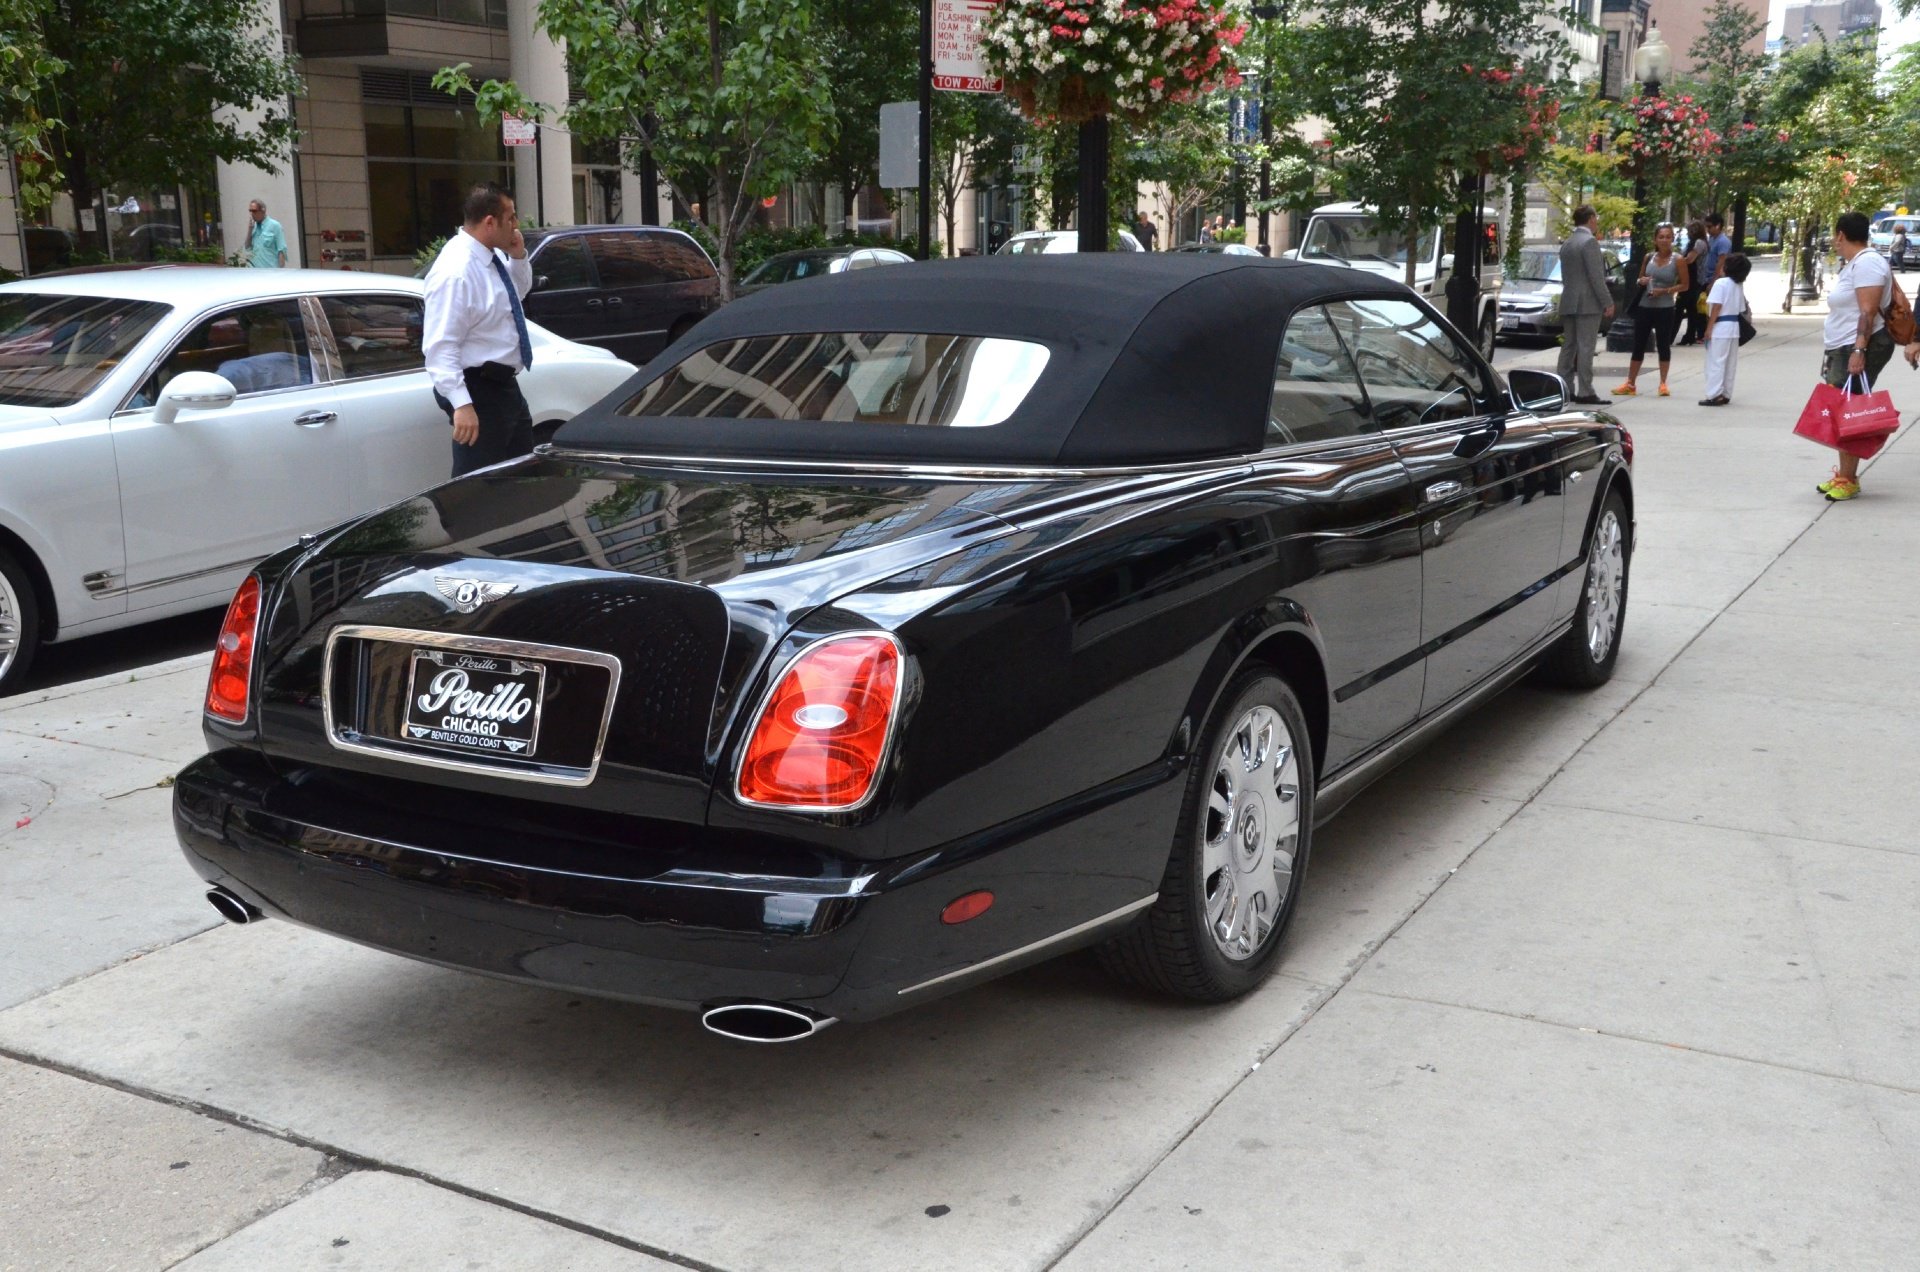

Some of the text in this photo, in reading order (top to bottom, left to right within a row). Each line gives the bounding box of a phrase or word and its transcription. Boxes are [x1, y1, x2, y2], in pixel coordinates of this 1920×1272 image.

[938, 3, 953, 11] USE
[938, 12, 974, 23] FLASHING
[937, 32, 955, 40] MON
[937, 51, 950, 59] FRI
[956, 53, 973, 61] SUN
[937, 76, 996, 90] TOW ZONE
[455, 655, 498, 670] Perillo
[417, 668, 532, 723] Perillo
[441, 716, 499, 736] CHICAGO
[430, 730, 502, 748] BENTLEY GOLD COAST
